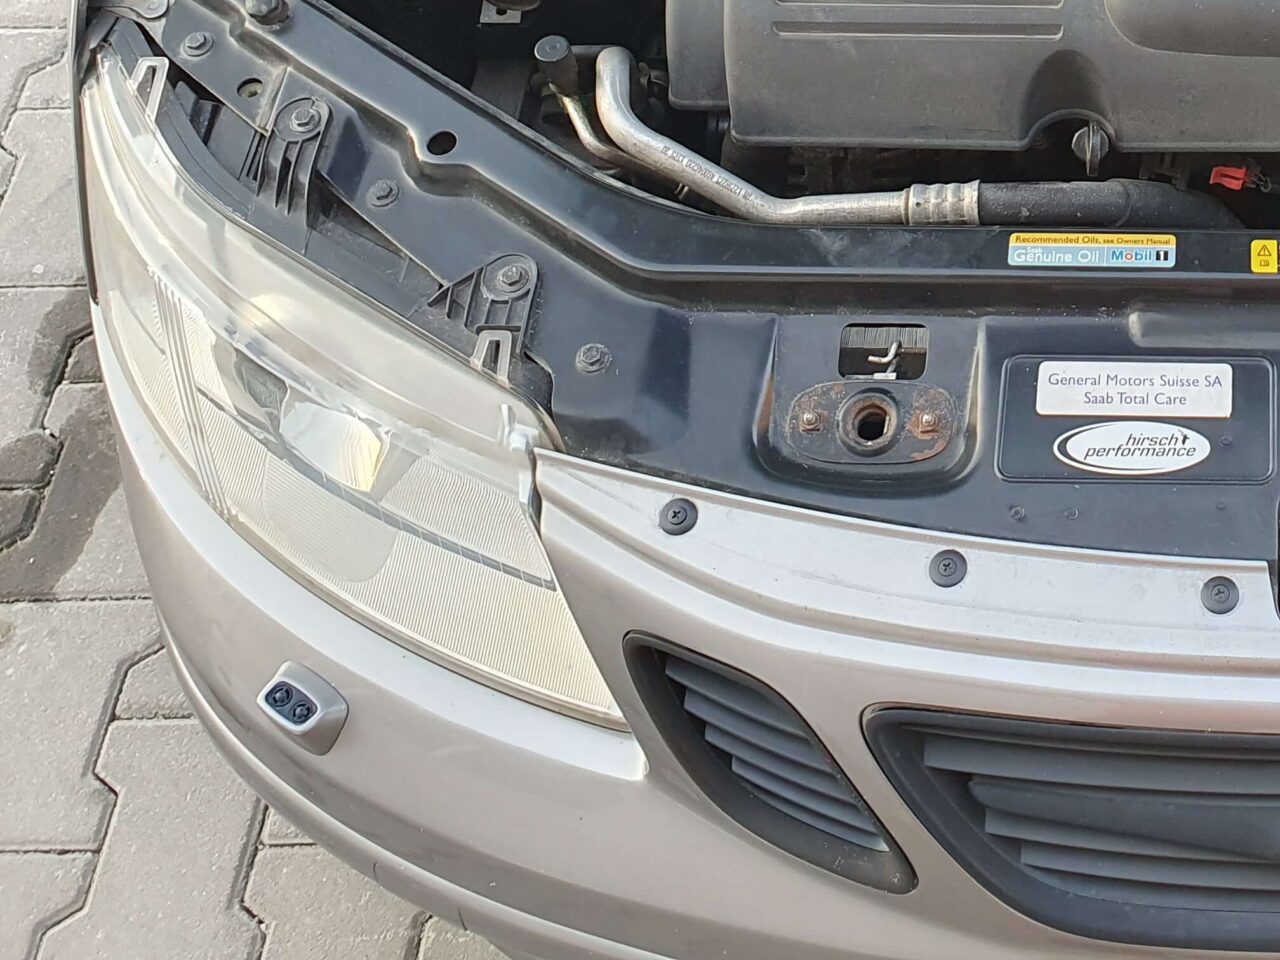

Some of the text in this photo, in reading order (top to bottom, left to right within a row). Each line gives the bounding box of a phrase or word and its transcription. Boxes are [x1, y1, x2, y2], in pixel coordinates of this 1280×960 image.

[1015, 235, 1079, 244] Recommended
[1082, 236, 1101, 245] Oils,
[1014, 249, 1099, 263] Genuine Oil
[1111, 250, 1152, 262] Mobil
[1048, 373, 1223, 388] General Motors Suisse SA
[1084, 391, 1187, 405] Saab Total Care
[1084, 433, 1196, 460] hirsch performance
